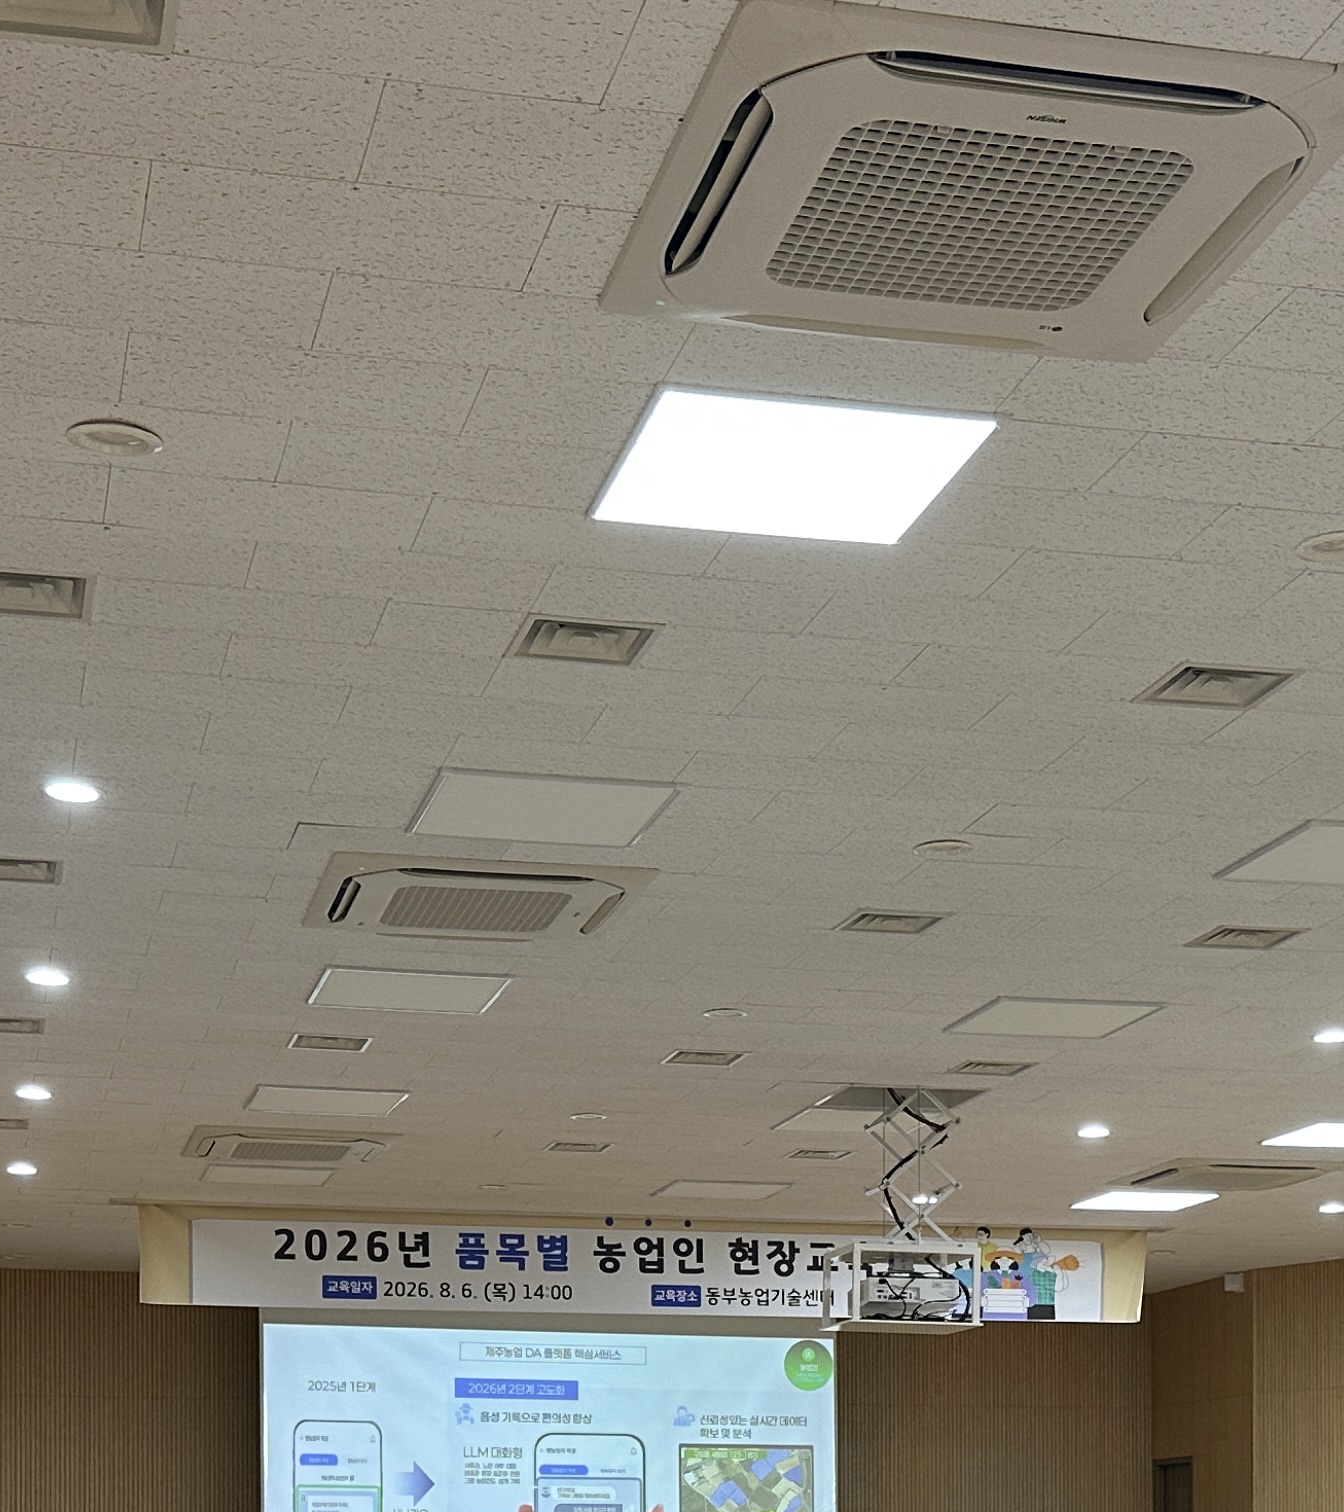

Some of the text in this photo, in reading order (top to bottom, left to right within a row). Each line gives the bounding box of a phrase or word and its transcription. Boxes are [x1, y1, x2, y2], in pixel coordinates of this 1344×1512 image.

[273, 1228, 431, 1269] 2026년
[455, 1232, 569, 1272] 품목별
[593, 1234, 704, 1275] 농업인
[327, 1280, 373, 1295] 교육일자
[383, 1281, 573, 1301] 2026. 8. 6. (목) 14:00
[654, 1289, 698, 1303] 교육장소
[485, 1346, 523, 1358] 제주농업
[525, 1348, 542, 1358] DA
[544, 1348, 572, 1360] 플랫폼
[307, 1380, 377, 1393] 2025년 1단계
[468, 1383, 566, 1396] 2026년 2단계 고도화
[480, 1411, 592, 1425] 음성 기록으로 편의성 향상
[749, 1415, 778, 1426] 실시간
[779, 1416, 808, 1427] 데이터
[700, 1428, 719, 1439] 확보
[733, 1429, 752, 1439] 분석
[463, 1446, 523, 1459] LLM 대화형
